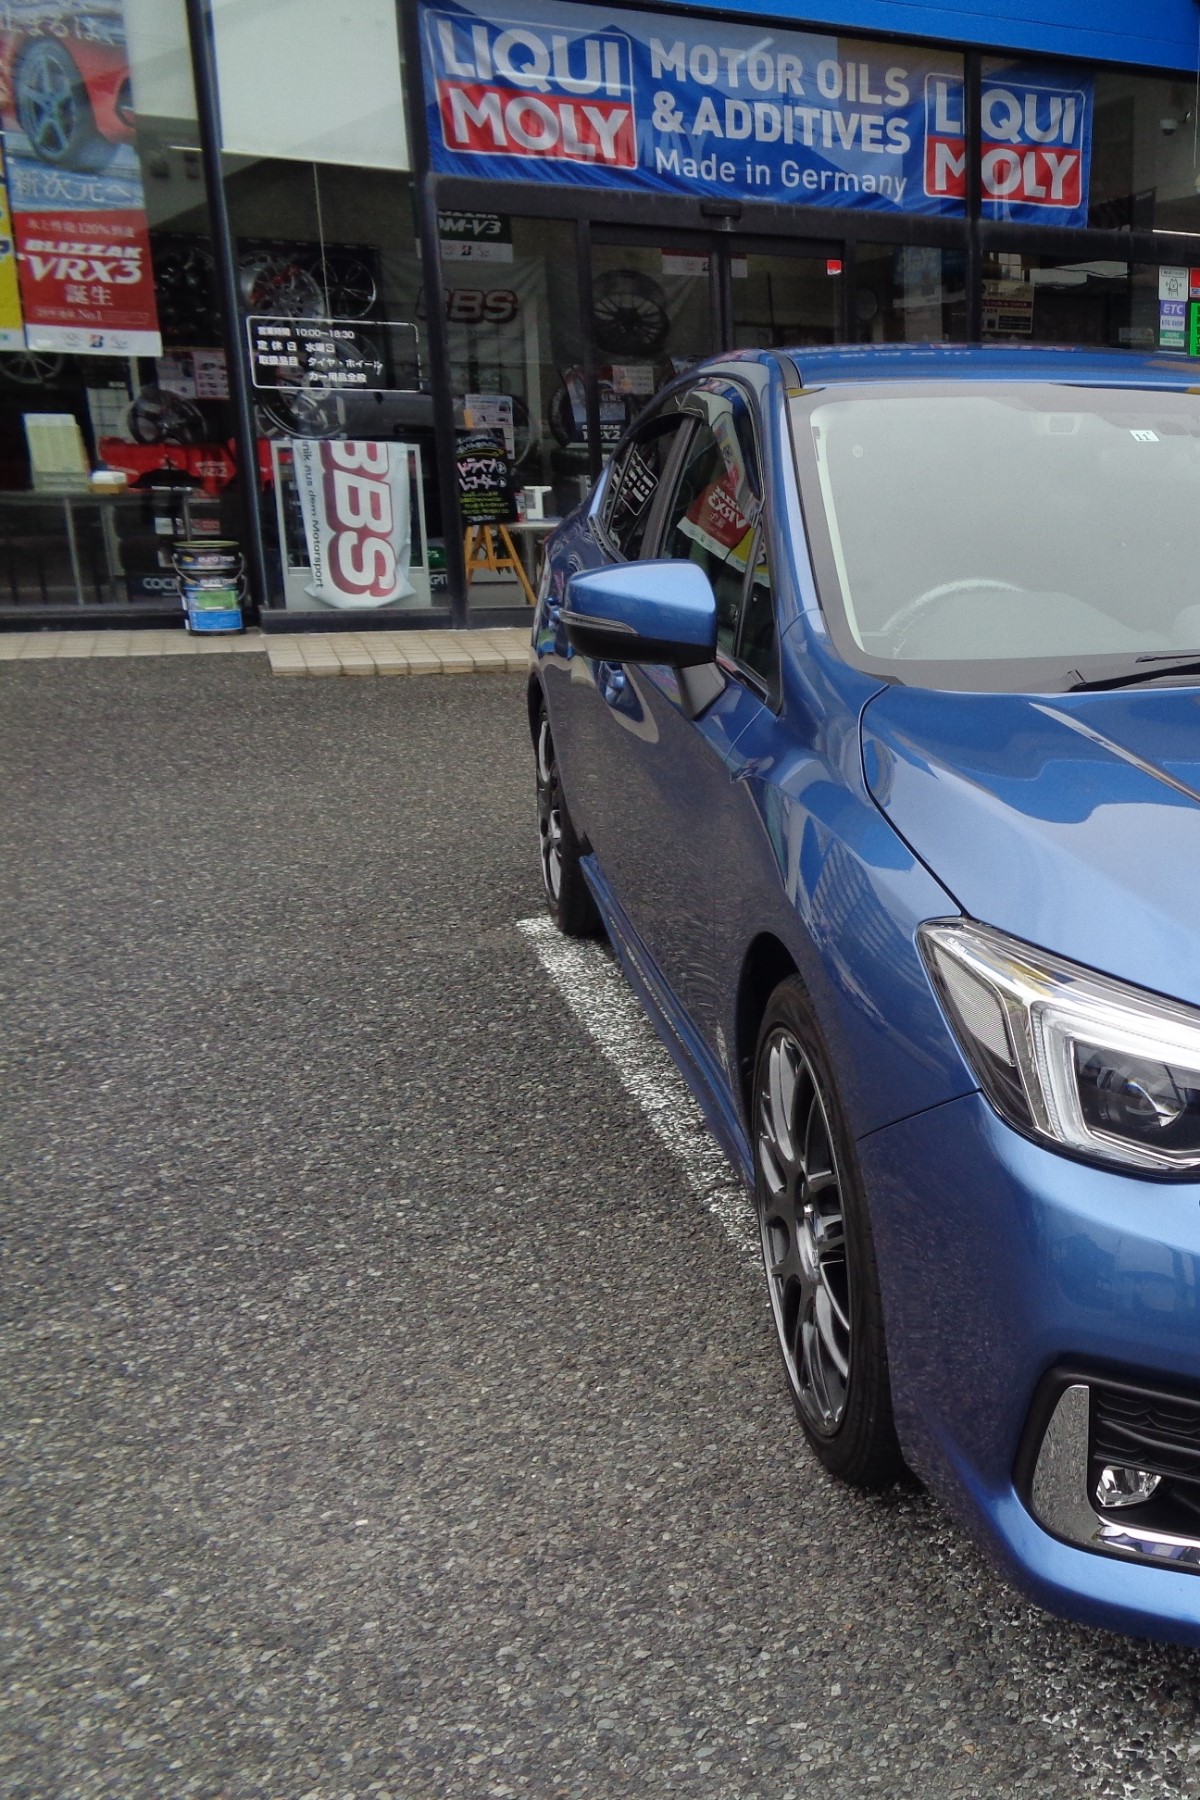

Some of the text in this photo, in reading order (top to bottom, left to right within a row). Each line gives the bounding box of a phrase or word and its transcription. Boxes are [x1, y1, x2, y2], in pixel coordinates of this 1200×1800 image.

[437, 19, 622, 97] LIQUI
[650, 37, 910, 108] MOTOR OILS
[448, 87, 629, 159] MOLY
[651, 90, 911, 156] & ADDITIVES
[935, 81, 1076, 144] LQUI
[654, 146, 907, 203] Made in Germany
[16, 252, 142, 285] VRX3
[26, 239, 143, 259] BLIZZAK
[65, 284, 113, 306] 誕生
[1163, 304, 1184, 315] ETC
[319, 441, 397, 598] BBS
[312, 519, 325, 589] Motorsport
